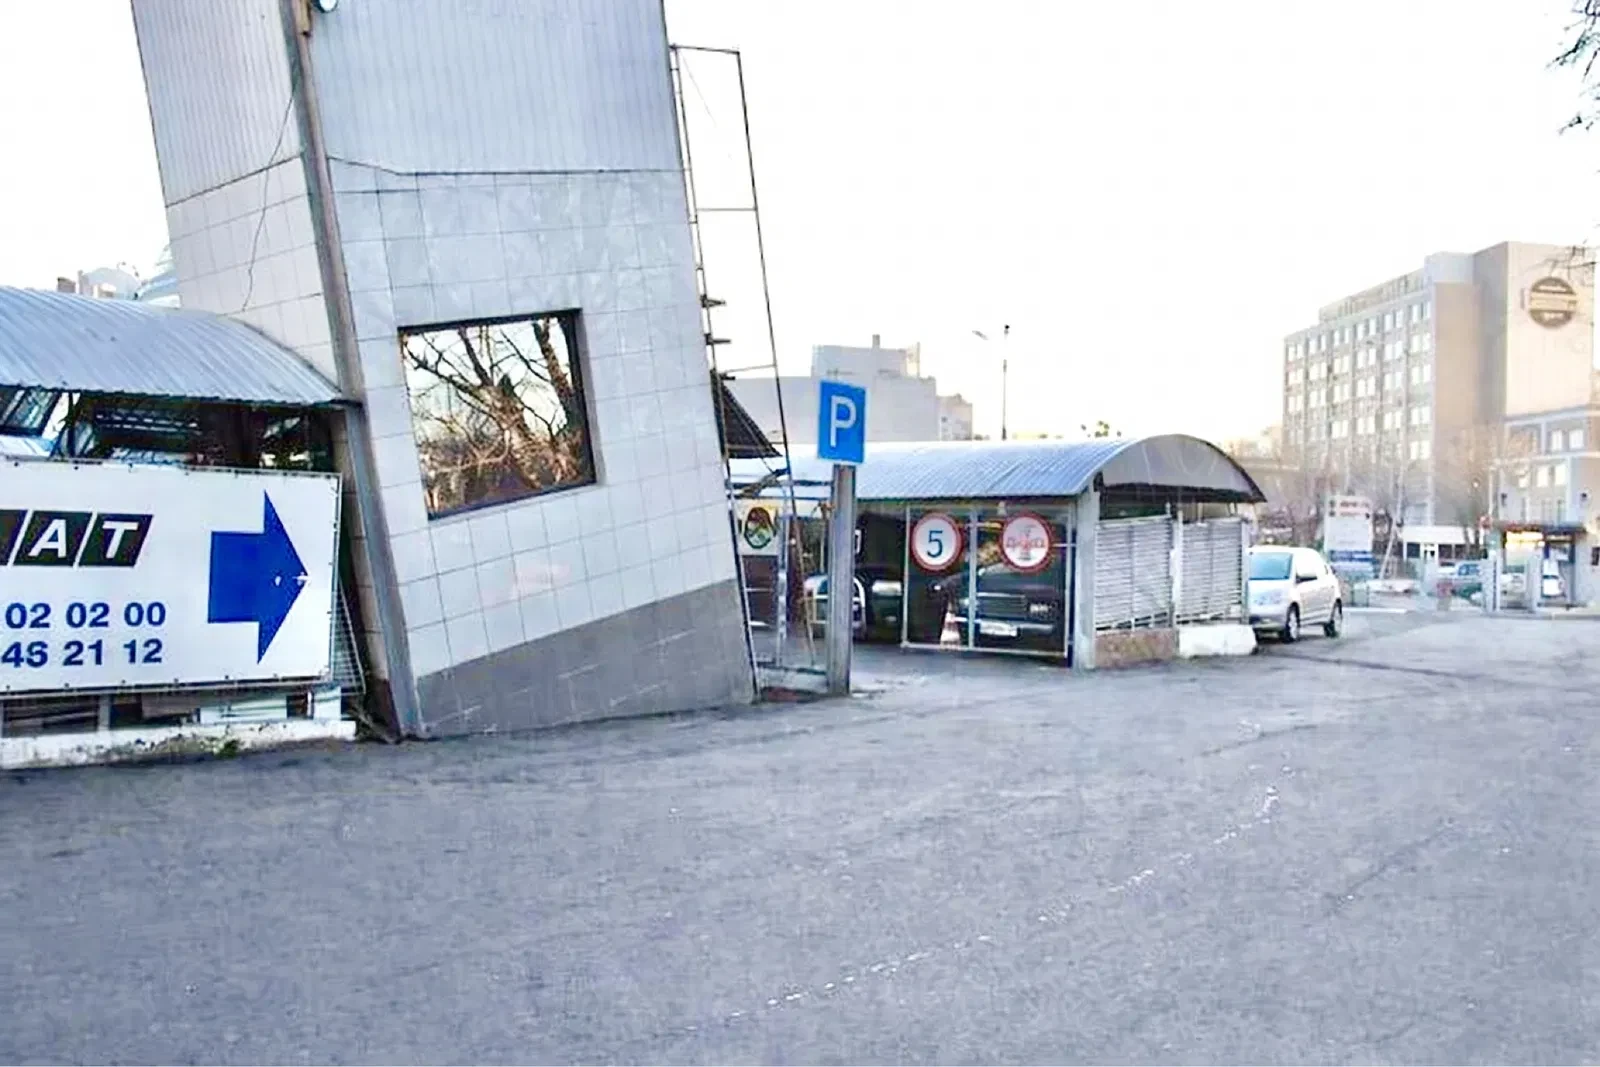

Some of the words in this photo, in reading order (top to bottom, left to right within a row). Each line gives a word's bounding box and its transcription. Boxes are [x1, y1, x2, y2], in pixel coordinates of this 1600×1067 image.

[830, 395, 857, 448] P
[927, 530, 943, 558] 5
[5, 602, 51, 629] 02
[66, 602, 110, 628] 02
[124, 602, 166, 627] 00
[62, 639, 103, 666] 21
[123, 638, 163, 664] 12
